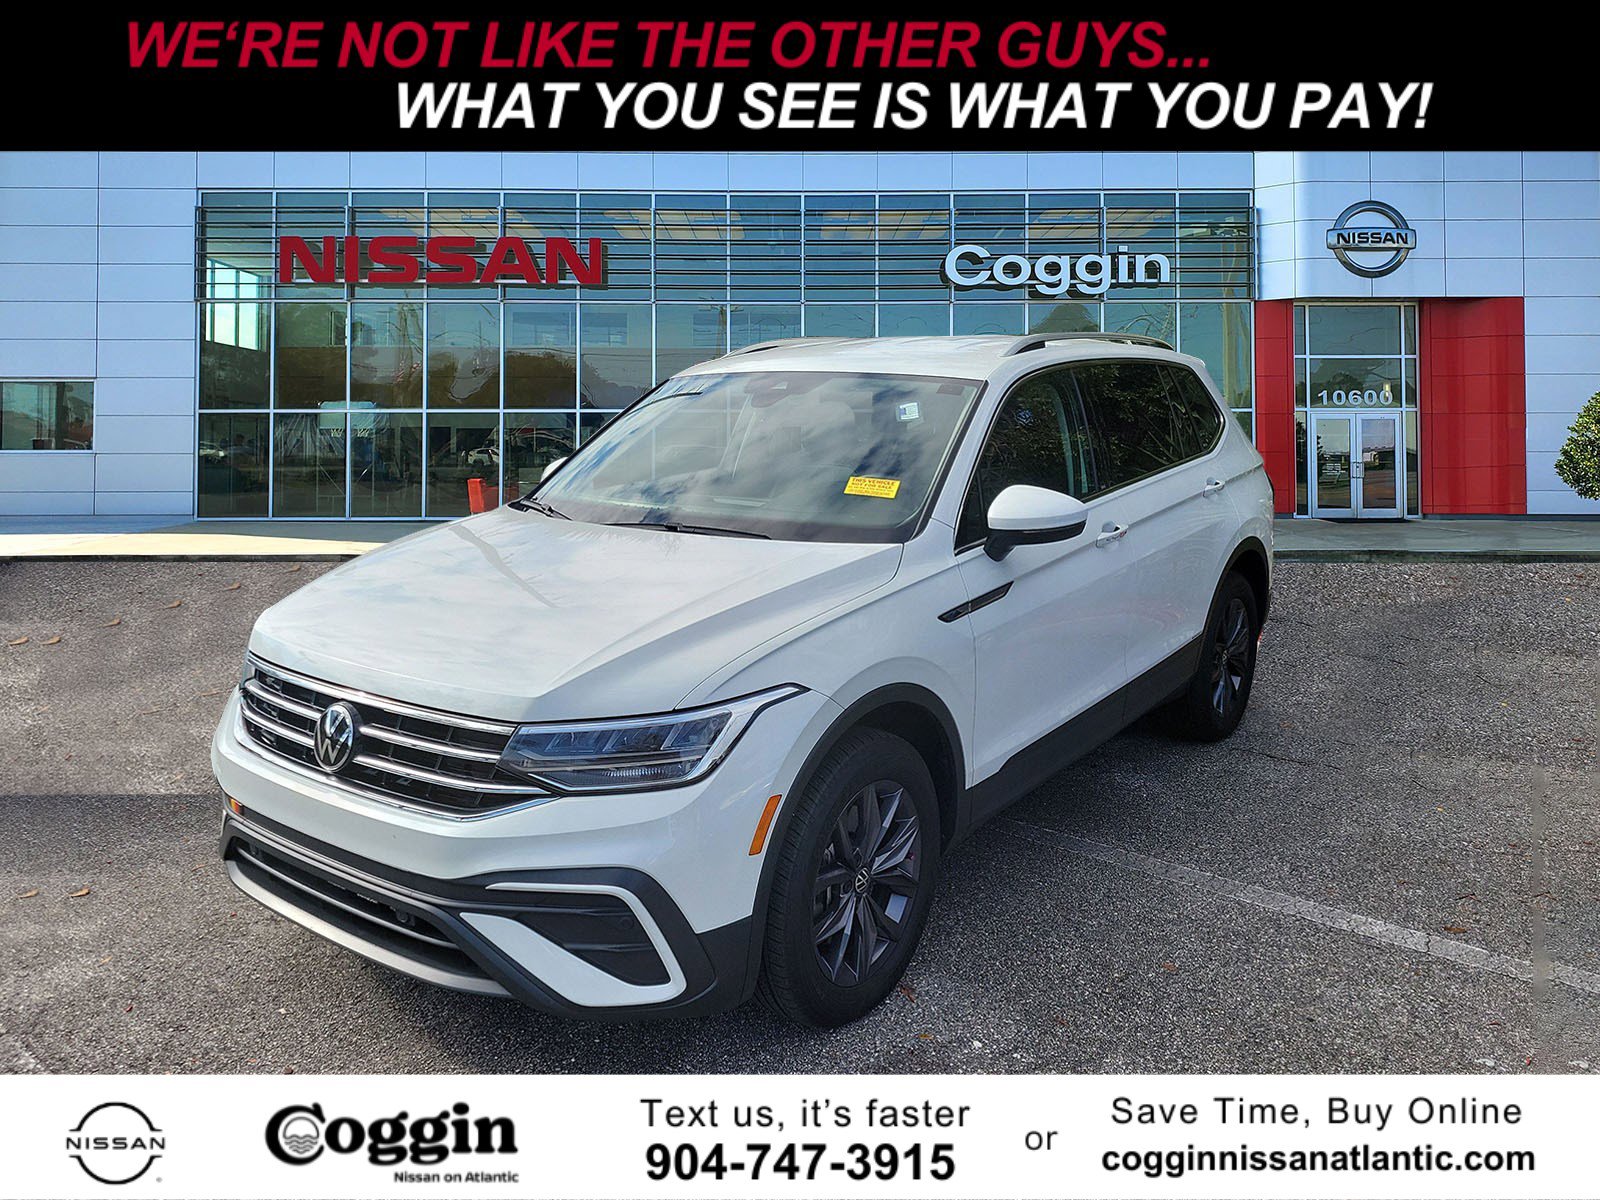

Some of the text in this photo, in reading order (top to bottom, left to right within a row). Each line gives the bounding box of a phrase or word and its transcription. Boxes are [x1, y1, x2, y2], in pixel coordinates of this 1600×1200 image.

[1336, 231, 1409, 245] NISSAN
[279, 236, 602, 284] NISSAN
[945, 245, 1171, 295] Coggin
[1317, 389, 1393, 406] 10600
